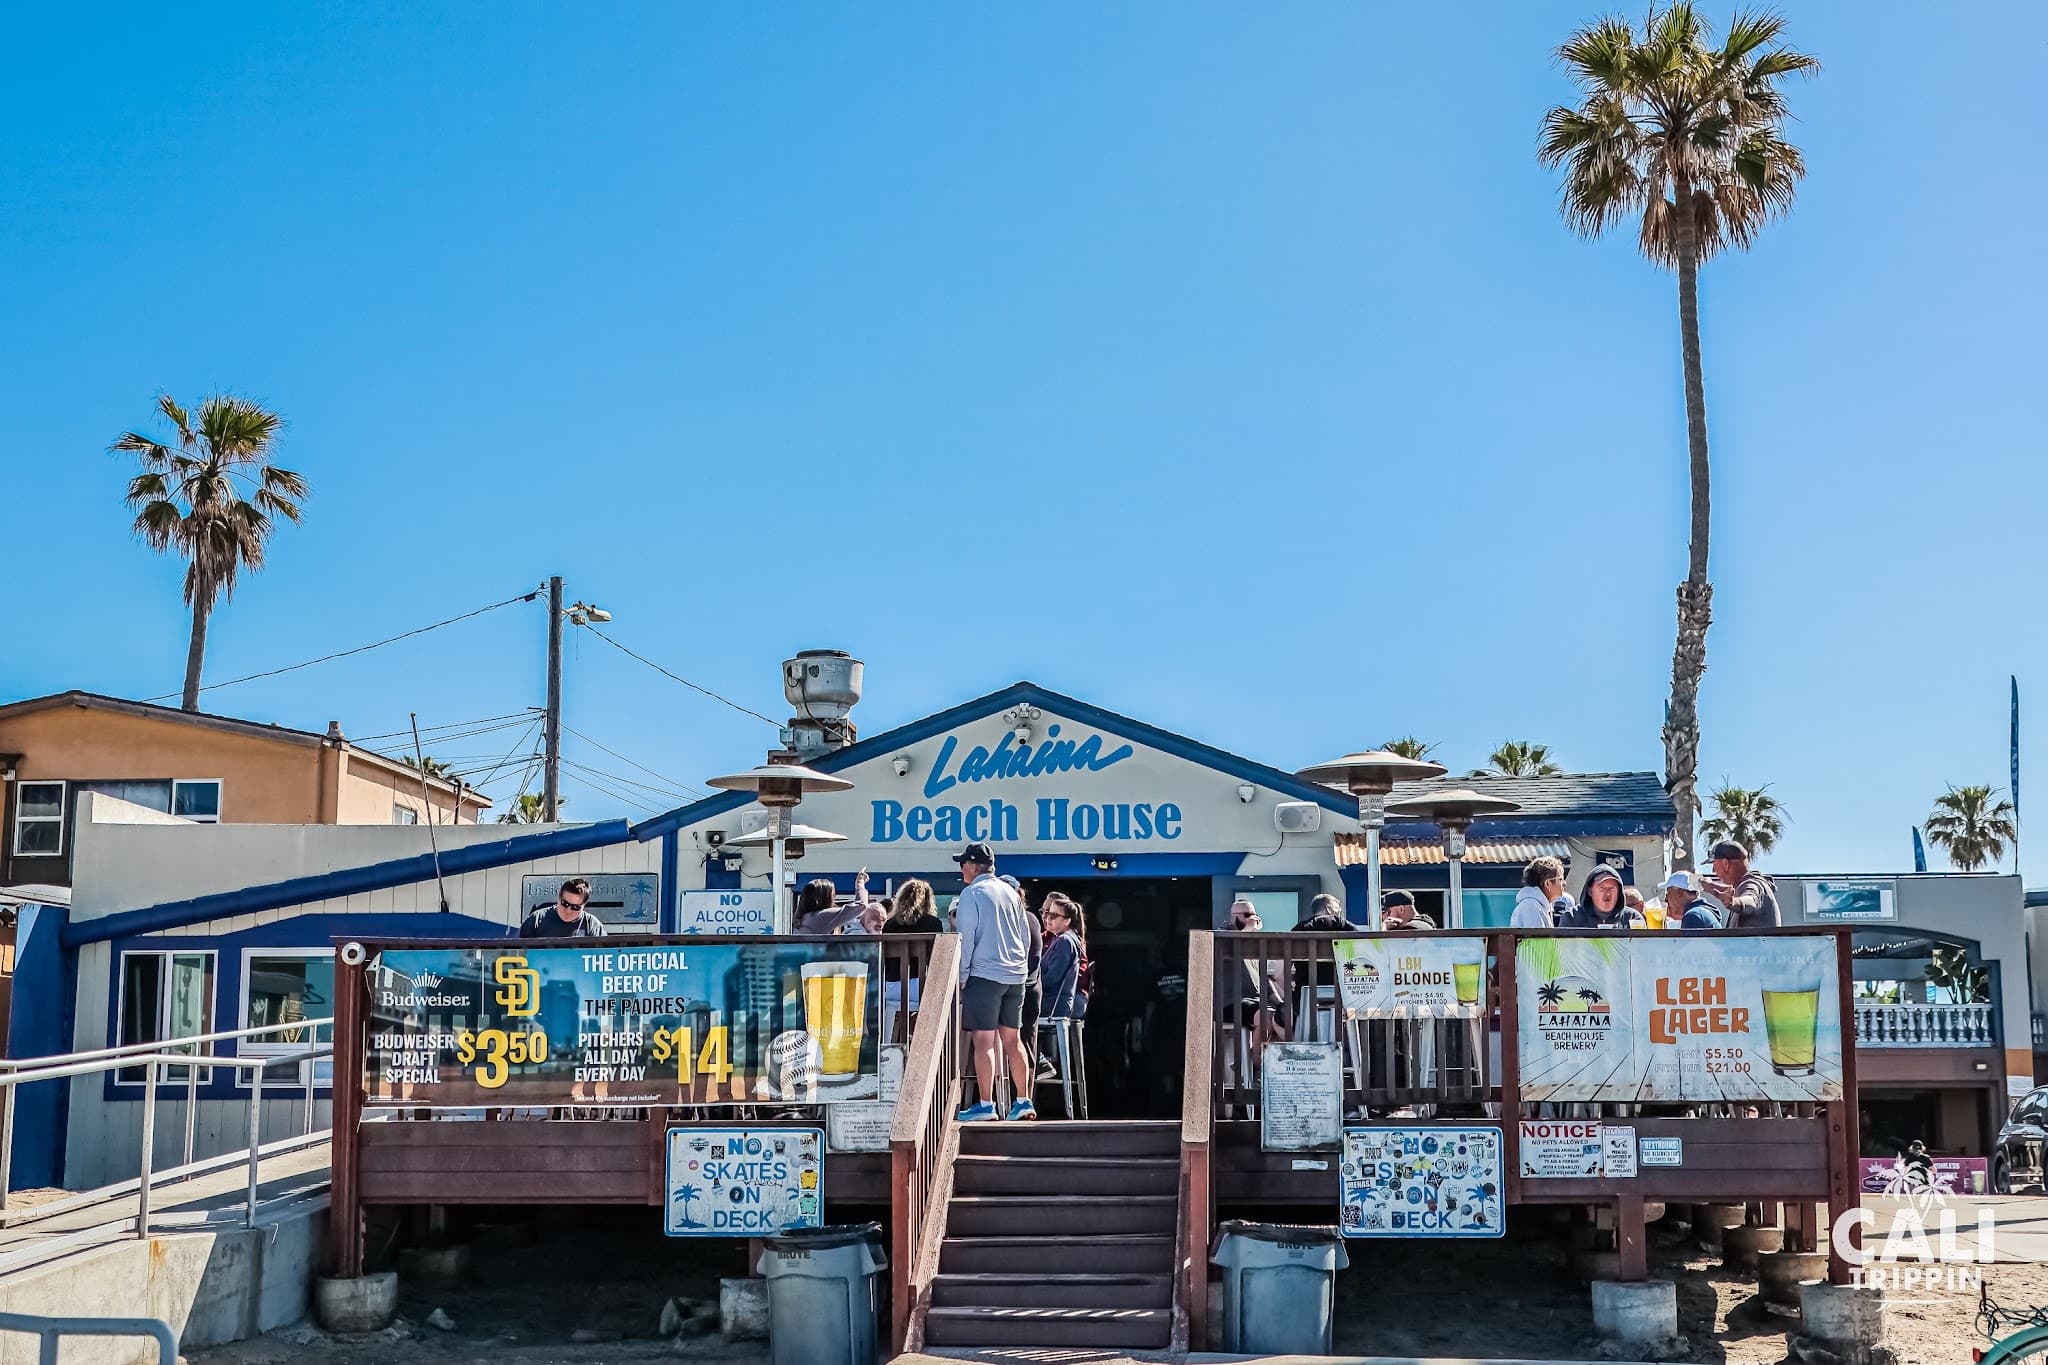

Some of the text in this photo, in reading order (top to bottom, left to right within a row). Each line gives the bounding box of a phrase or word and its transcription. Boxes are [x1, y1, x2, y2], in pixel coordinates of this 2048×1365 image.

[923, 724, 1133, 798] Lahaina
[871, 798, 1182, 842] Beach House
[720, 895, 742, 905] NO
[696, 910, 766, 922] ALCOHOL
[716, 926, 745, 935] OFF
[582, 952, 689, 973] THE OFFICIAL
[1397, 957, 1422, 970] LBH
[495, 956, 541, 1017] SD
[602, 974, 668, 994] BEER OF
[1394, 972, 1451, 985] BLONDE
[381, 991, 470, 1007] Budweiser
[1656, 977, 1726, 1005] LBH
[584, 997, 686, 1016] THE PADRES
[1538, 1015, 1611, 1027] LAHAINA
[1649, 1007, 1749, 1045] LAGER
[374, 1034, 454, 1049] BUDWEISER
[578, 1031, 644, 1048] PITCHERS
[1545, 1032, 1605, 1040] BEACH HOUSE
[1554, 1042, 1597, 1050] BREWERY
[1705, 1048, 1744, 1059] $5.50
[391, 1051, 436, 1066] DRAFT
[584, 1049, 637, 1065] ALL DAY
[652, 1025, 733, 1084] $14
[574, 1066, 646, 1082] EVERY DAY
[1706, 1062, 1751, 1073] $21.00
[386, 1068, 441, 1084] SPECIAL
[1522, 1125, 1598, 1138] NOTICE
[728, 1138, 762, 1155] NO
[702, 1162, 788, 1180] SKATES
[713, 1210, 774, 1228] DECK
[1392, 1210, 1454, 1229] DECK
